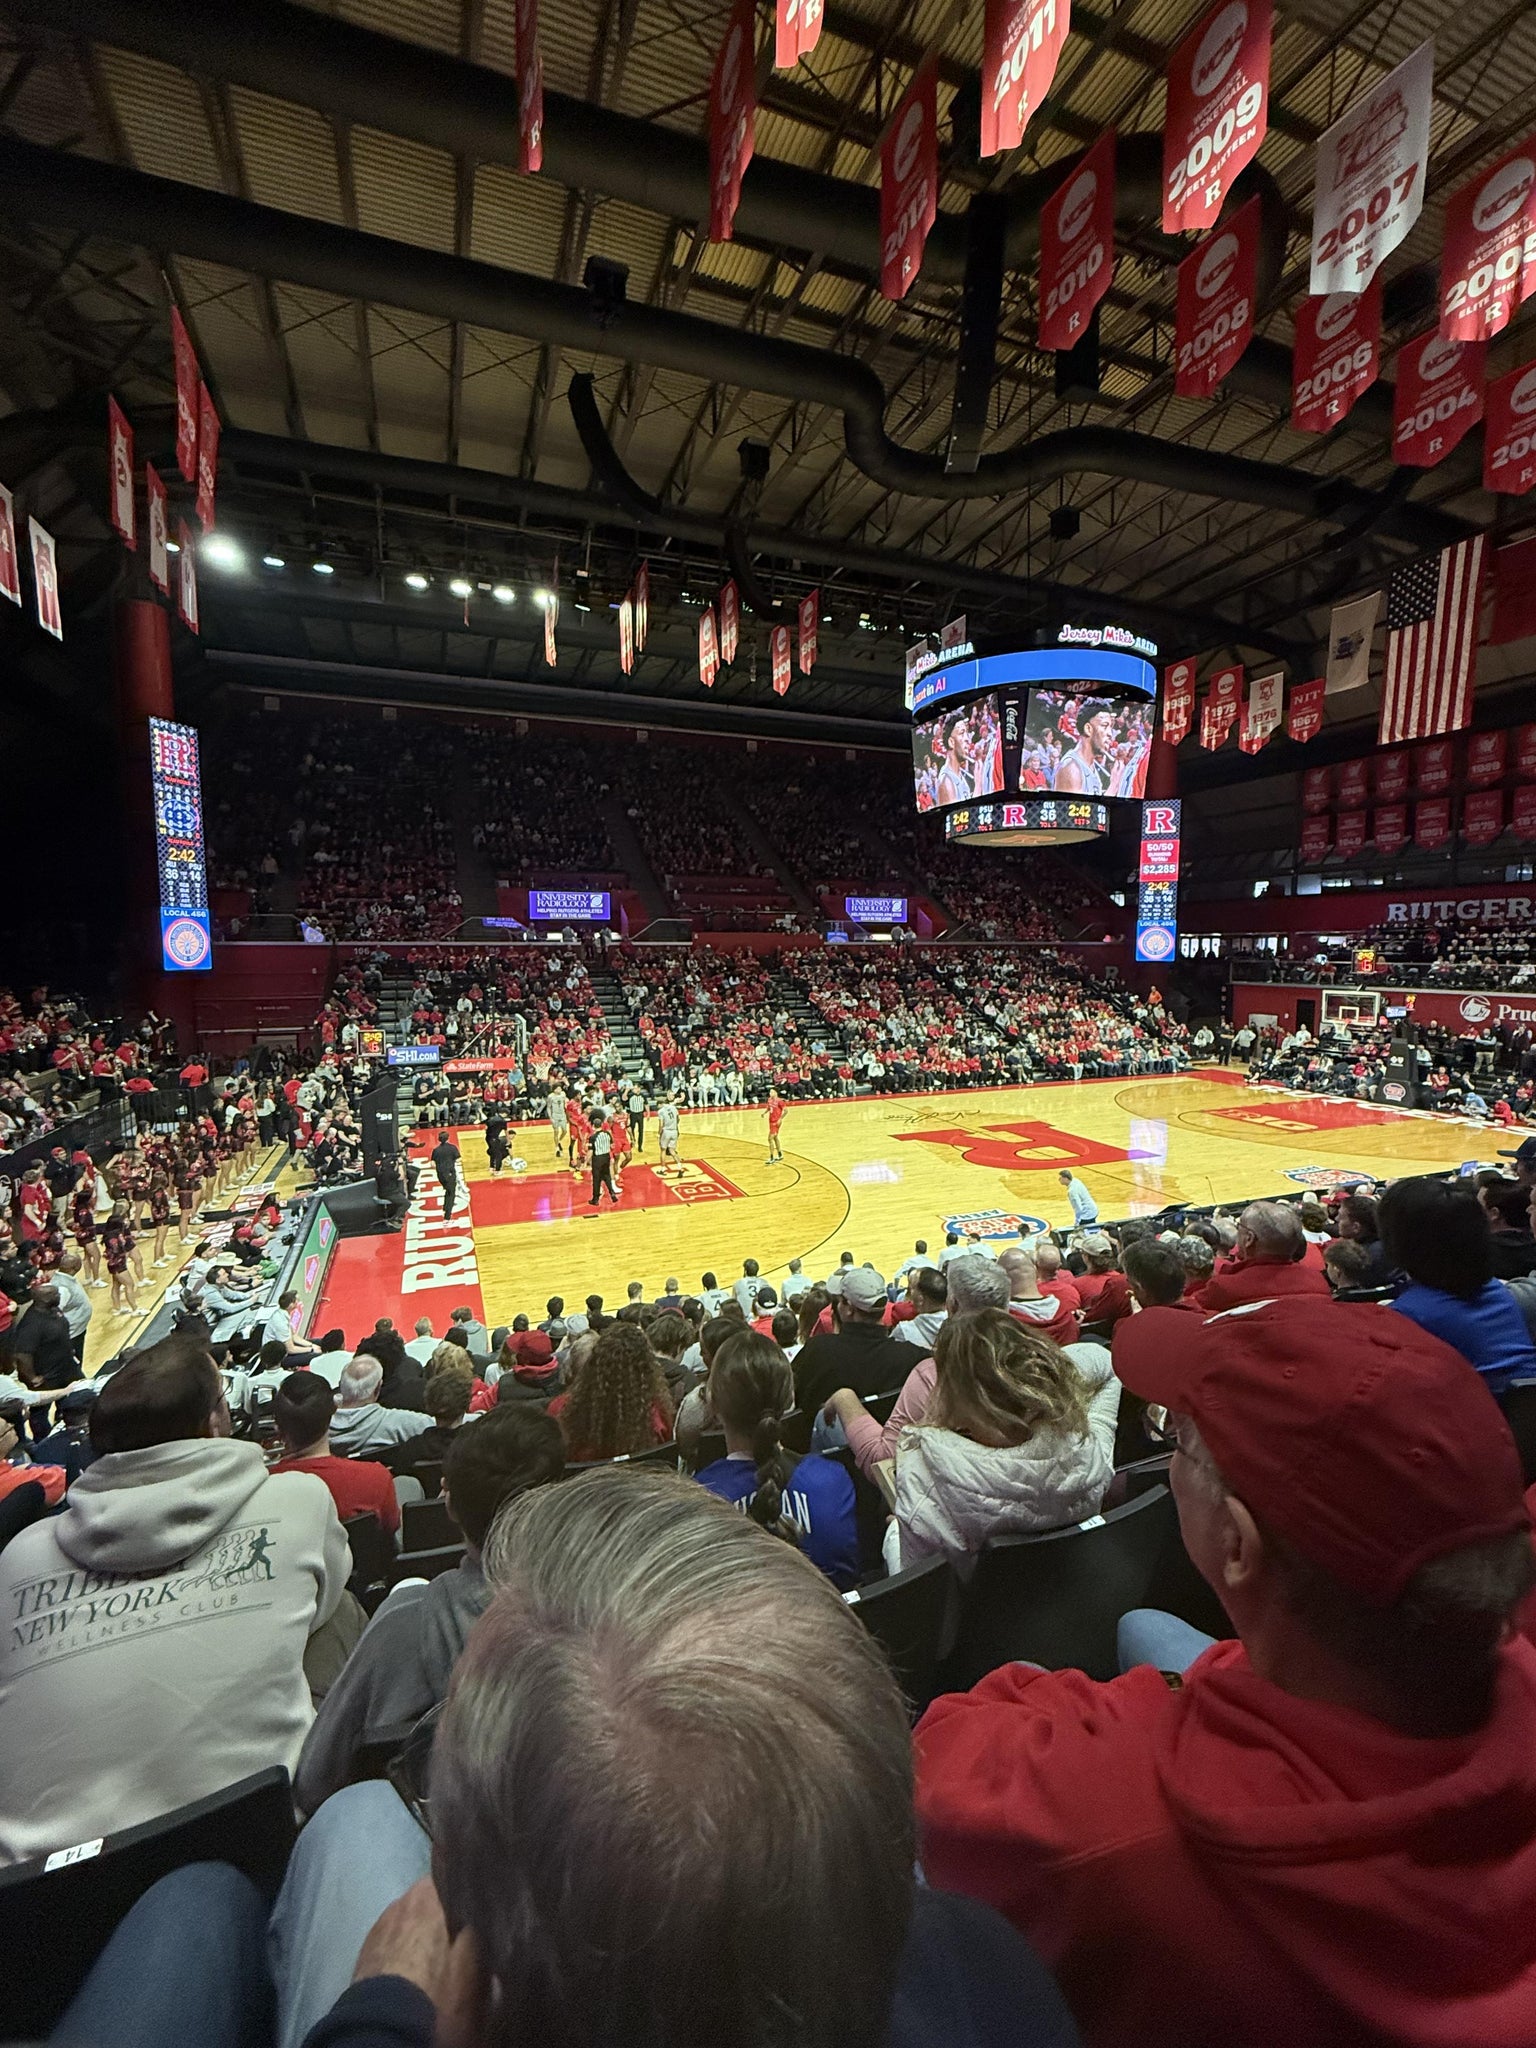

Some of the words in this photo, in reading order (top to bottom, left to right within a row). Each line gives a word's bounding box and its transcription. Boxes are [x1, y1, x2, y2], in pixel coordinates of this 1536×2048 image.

[994, 0, 1056, 112] 2011
[1187, 76, 1248, 144] BASKETBALL
[1168, 81, 1262, 202] 2009
[1175, 174, 1206, 213] SWEET
[1210, 125, 1256, 178] SIXTEEN
[1205, 178, 1222, 209] R
[1478, 174, 1532, 226] NCAA
[1316, 162, 1419, 266] 2007
[1475, 213, 1529, 256] WOMEN'S
[1467, 220, 1536, 270] BASKETBALL
[1355, 249, 1373, 275] R
[1046, 243, 1103, 321] 2010
[1458, 294, 1490, 319] ELITE
[1485, 301, 1502, 324] R
[1069, 311, 1080, 333] R
[1178, 298, 1249, 372] 2008
[1295, 341, 1372, 407] 2006
[1325, 399, 1339, 417] R
[1397, 384, 1477, 443] 2004
[1428, 437, 1443, 454] R
[1520, 465, 1533, 483] R
[1058, 624, 1102, 647] Jersey
[1103, 626, 1135, 647] Mike's
[1135, 637, 1158, 656] ARENA
[938, 642, 974, 662] ARENA
[926, 684, 935, 696] in
[935, 677, 946, 693] AI
[1294, 689, 1321, 705] NIT
[1211, 702, 1237, 717] 1979
[1292, 713, 1319, 728] 1967
[979, 805, 993, 813] PSU
[1043, 801, 1055, 809] RU
[1068, 804, 1091, 817] 2:42
[953, 811, 969, 825] 2:42
[978, 814, 992, 824] 14
[1002, 804, 1027, 827] R
[1040, 810, 1057, 821] 36
[1145, 808, 1176, 833] R
[168, 847, 196, 862] 2:42
[1146, 843, 1174, 851] 50/50
[165, 860, 177, 868] RU
[1143, 864, 1176, 875] $2,285
[165, 868, 179, 880] 36
[189, 870, 201, 881] 14
[1147, 882, 1170, 891] 2:42
[537, 893, 588, 901] UNIVERSITY
[537, 900, 588, 908] RADIOLOGY
[1162, 895, 1172, 903] 14
[164, 909, 190, 917] LOCAL
[1388, 898, 1536, 922] RUTGER
[363, 1032, 383, 1042] 2:42
[396, 1049, 437, 1062] SHI.COM
[947, 1209, 999, 1221] ARENA
[11, 1607, 77, 1650] NEW
[85, 1578, 184, 1626] YORK
[38, 1611, 161, 1655] WELLNESS
[180, 1595, 240, 1616] CLUB
[64, 1847, 83, 1863] 14
